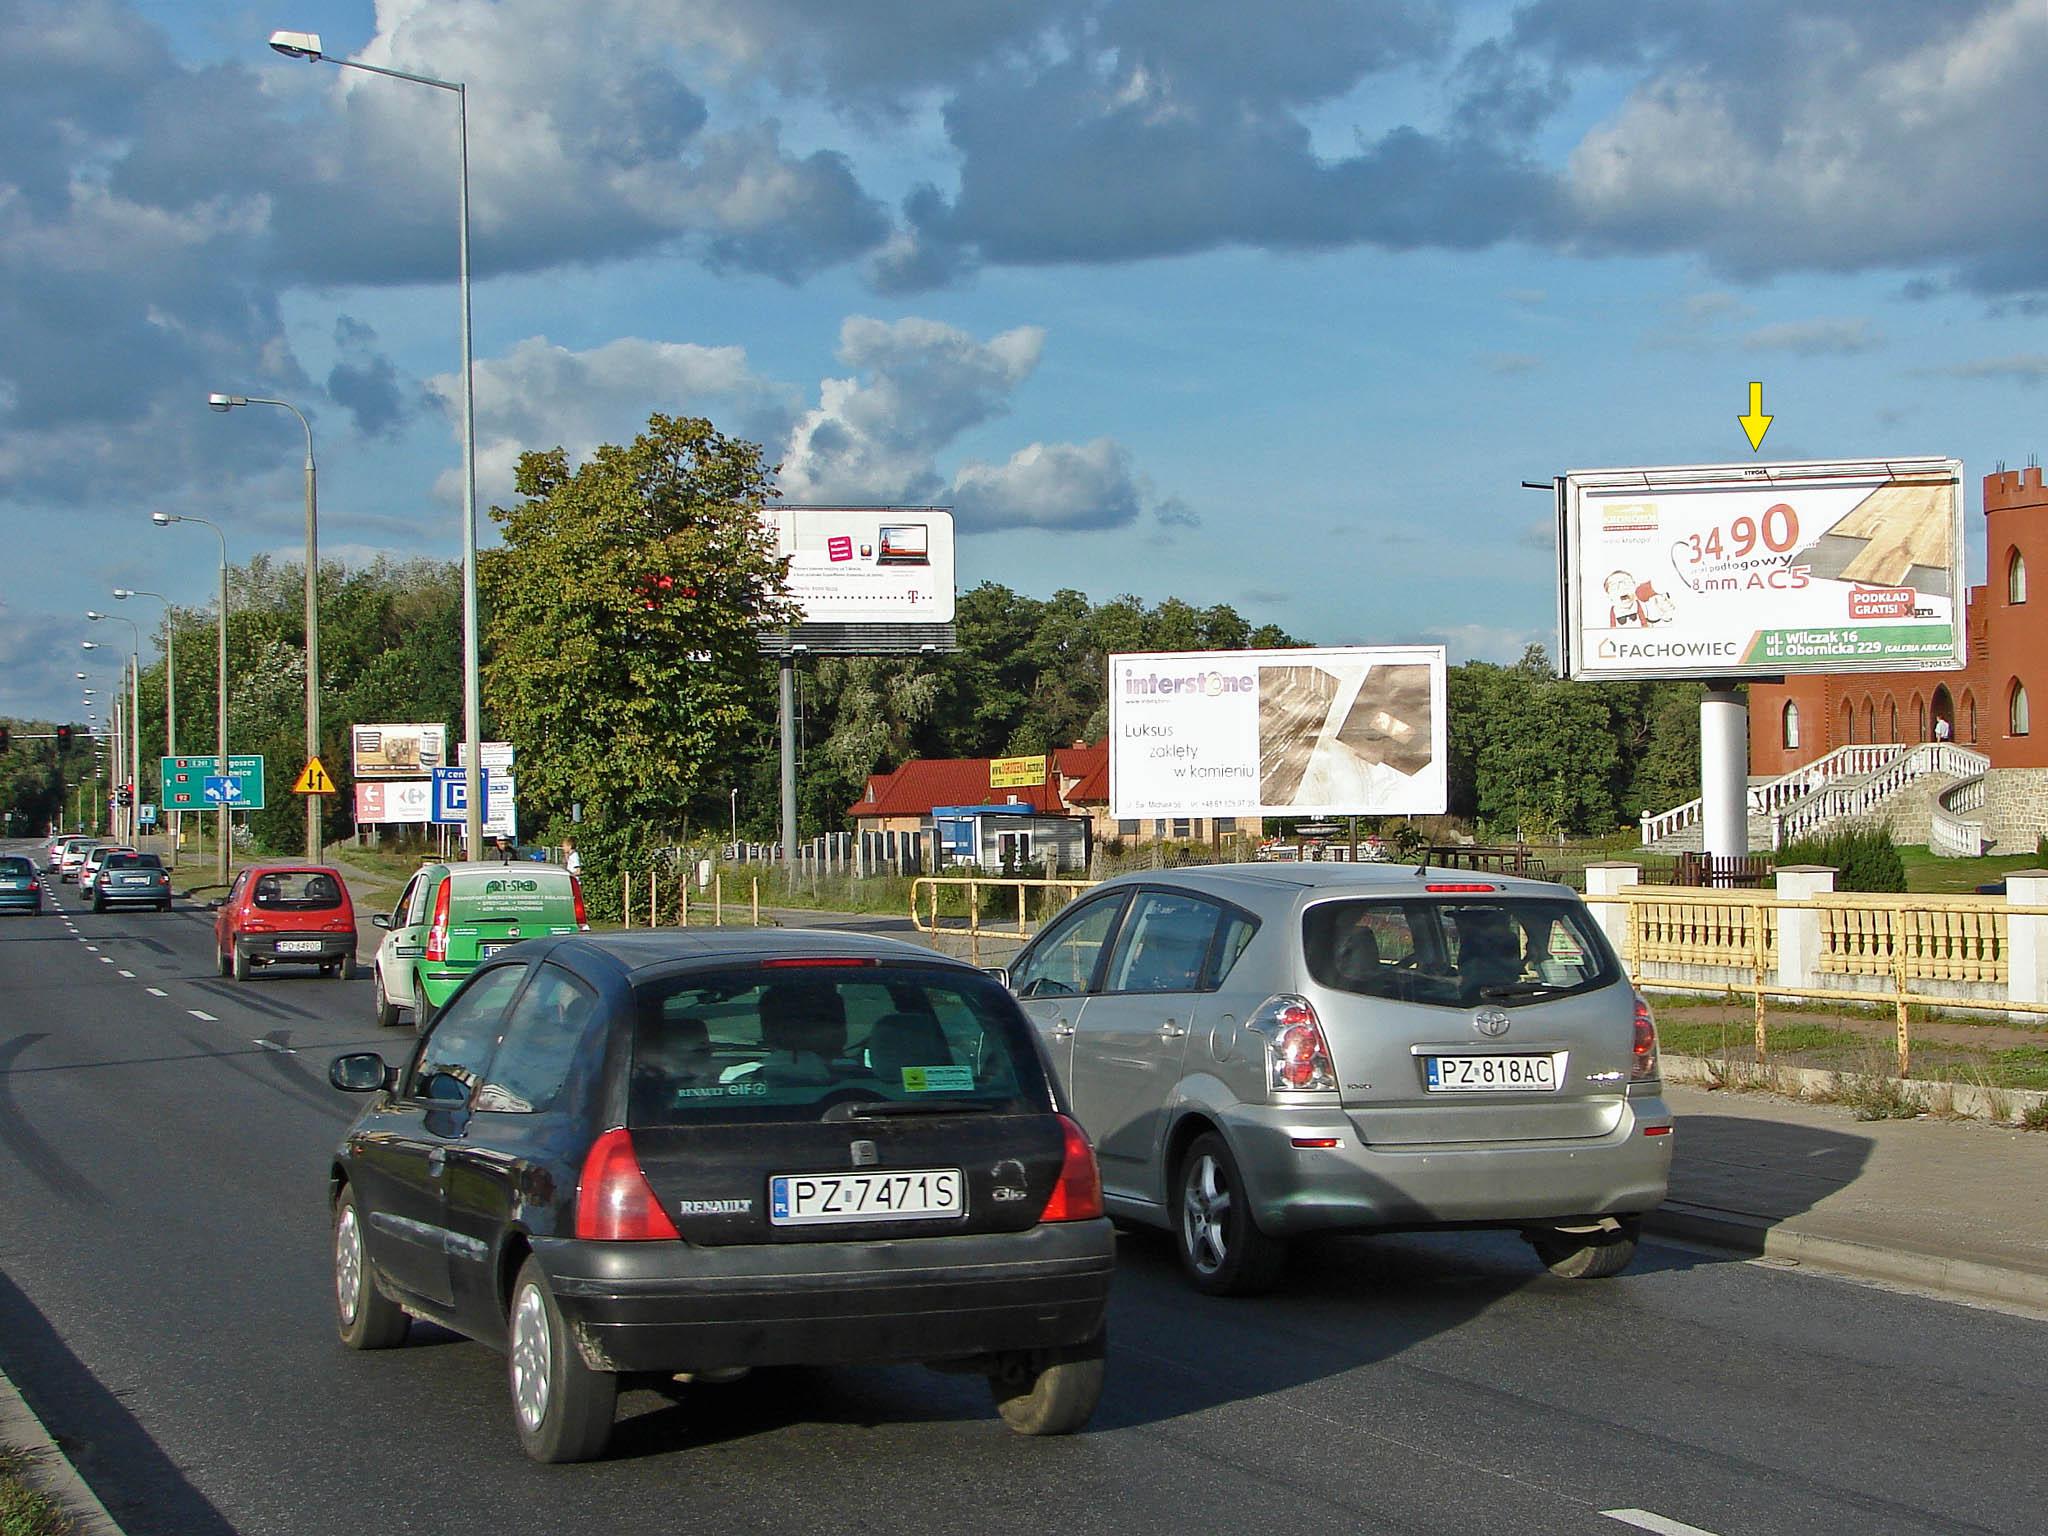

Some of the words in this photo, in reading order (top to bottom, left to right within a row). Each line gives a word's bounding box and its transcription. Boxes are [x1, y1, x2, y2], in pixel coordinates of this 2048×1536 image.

[1689, 503, 1800, 564] 34,90
[1692, 578, 1700, 591] 8
[1746, 567, 1811, 590] AC5
[1853, 592, 1910, 604] PODKŁAD
[1786, 631, 1839, 644] Wilczak
[1841, 631, 1858, 642] 16
[1619, 642, 1737, 658] FACHOWIEC
[1786, 642, 1855, 656] Obornicka
[1857, 641, 1882, 654] 229
[1125, 669, 1254, 697] interstone
[1125, 723, 1174, 738] Luksus
[1149, 743, 1199, 760] zaklęty
[436, 769, 445, 778] W
[1174, 768, 1186, 778] w
[1190, 764, 1254, 779] kamieniu
[1441, 1060, 1476, 1083] PZ
[1482, 1059, 1552, 1082] 818AC
[678, 1087, 724, 1097] RENAULT
[795, 1179, 843, 1213] PZ
[855, 1175, 954, 1212] 7471S
[679, 1199, 753, 1214] RENAULT
[774, 1202, 788, 1213] PL
